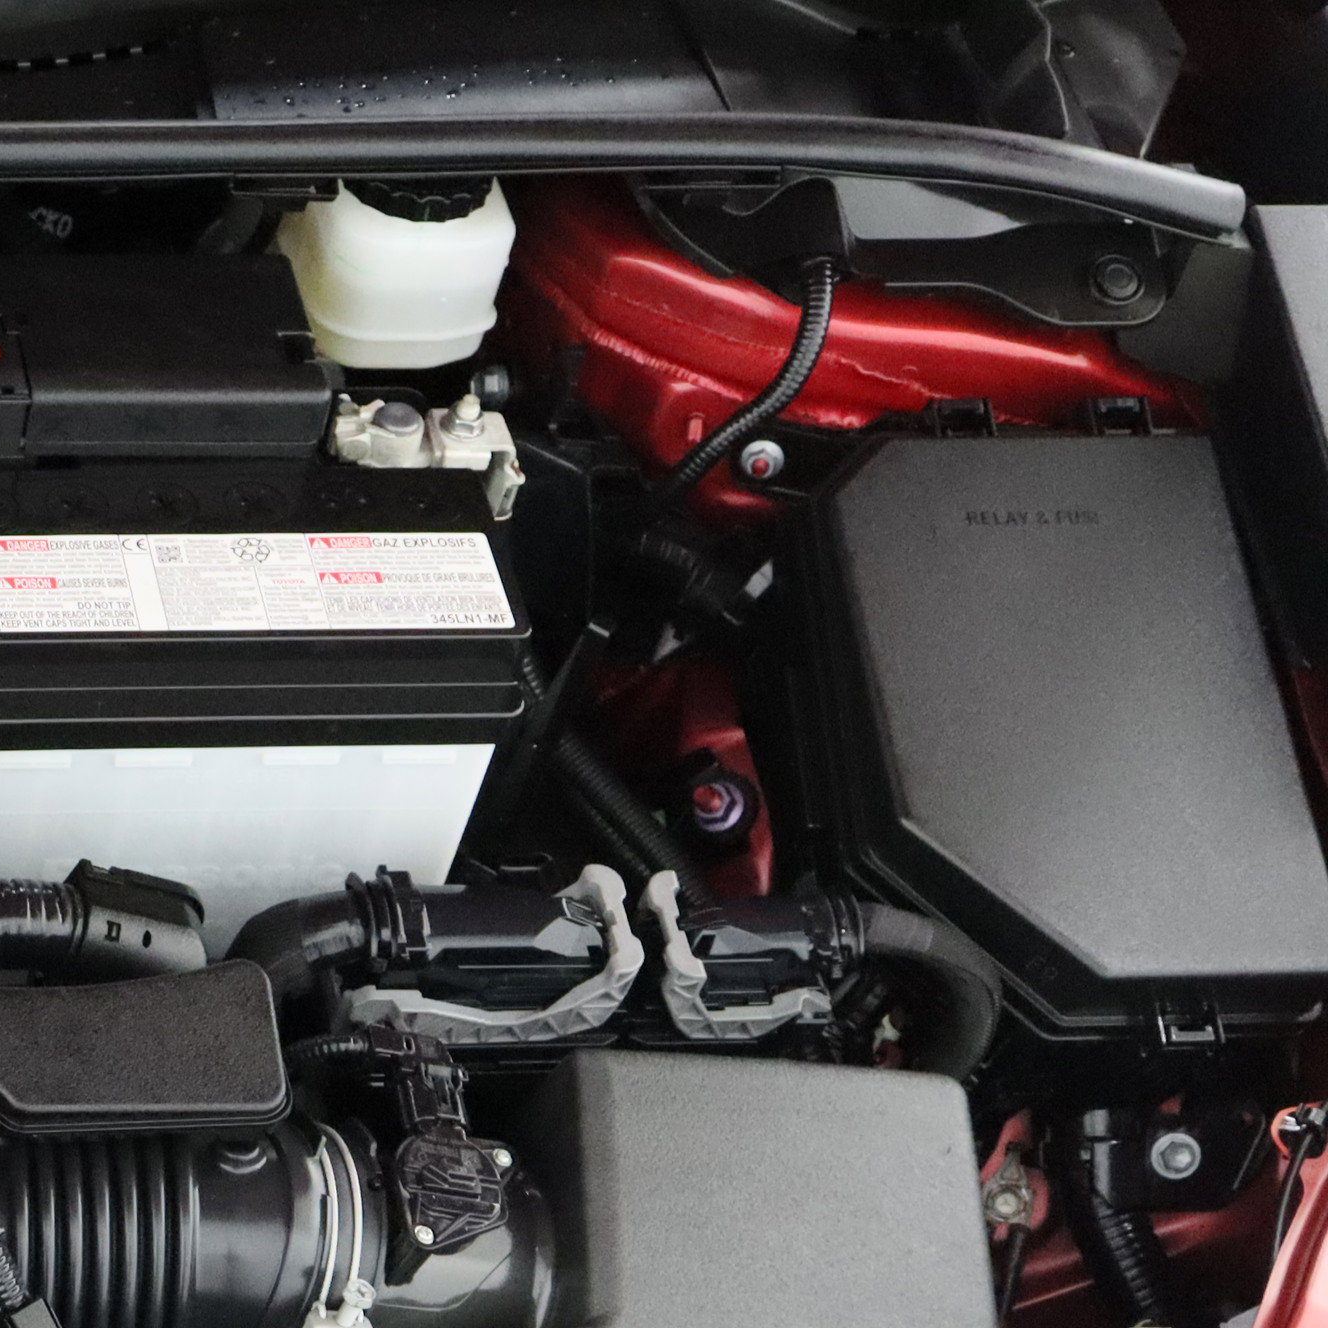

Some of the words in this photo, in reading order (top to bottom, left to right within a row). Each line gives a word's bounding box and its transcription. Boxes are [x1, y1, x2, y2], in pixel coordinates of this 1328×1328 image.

[965, 510, 1029, 526] RELAY
[6, 540, 47, 550] DANGER
[49, 540, 92, 550] EXPLOSIVE
[93, 539, 120, 550] GASES
[329, 537, 370, 549] DANGER
[372, 537, 399, 548] GAZ
[404, 537, 477, 548] EXPLOSIFS
[13, 578, 52, 589] POISON
[340, 573, 377, 584] POISON
[383, 573, 420, 584] PROVOQUE
[421, 573, 433, 583] DE
[434, 573, 456, 583] GRAVE
[77, 602, 91, 610] DO
[95, 602, 114, 610] NOT
[117, 601, 131, 609] TIP
[0, 611, 17, 620] KEEP
[18, 611, 35, 619] OUT
[36, 611, 45, 619] OF
[47, 611, 61, 619] THE
[62, 611, 86, 619] REACH
[87, 610, 97, 618] OF
[98, 610, 134, 618] CHILDREN
[430, 614, 508, 624] 345LN1-MF
[0, 620, 22, 628] KEEP
[24, 620, 44, 628] VENT
[46, 620, 67, 628] CAPS
[69, 619, 92, 628] TIGHT
[94, 619, 111, 627] AND
[112, 619, 137, 627] LEVEL
